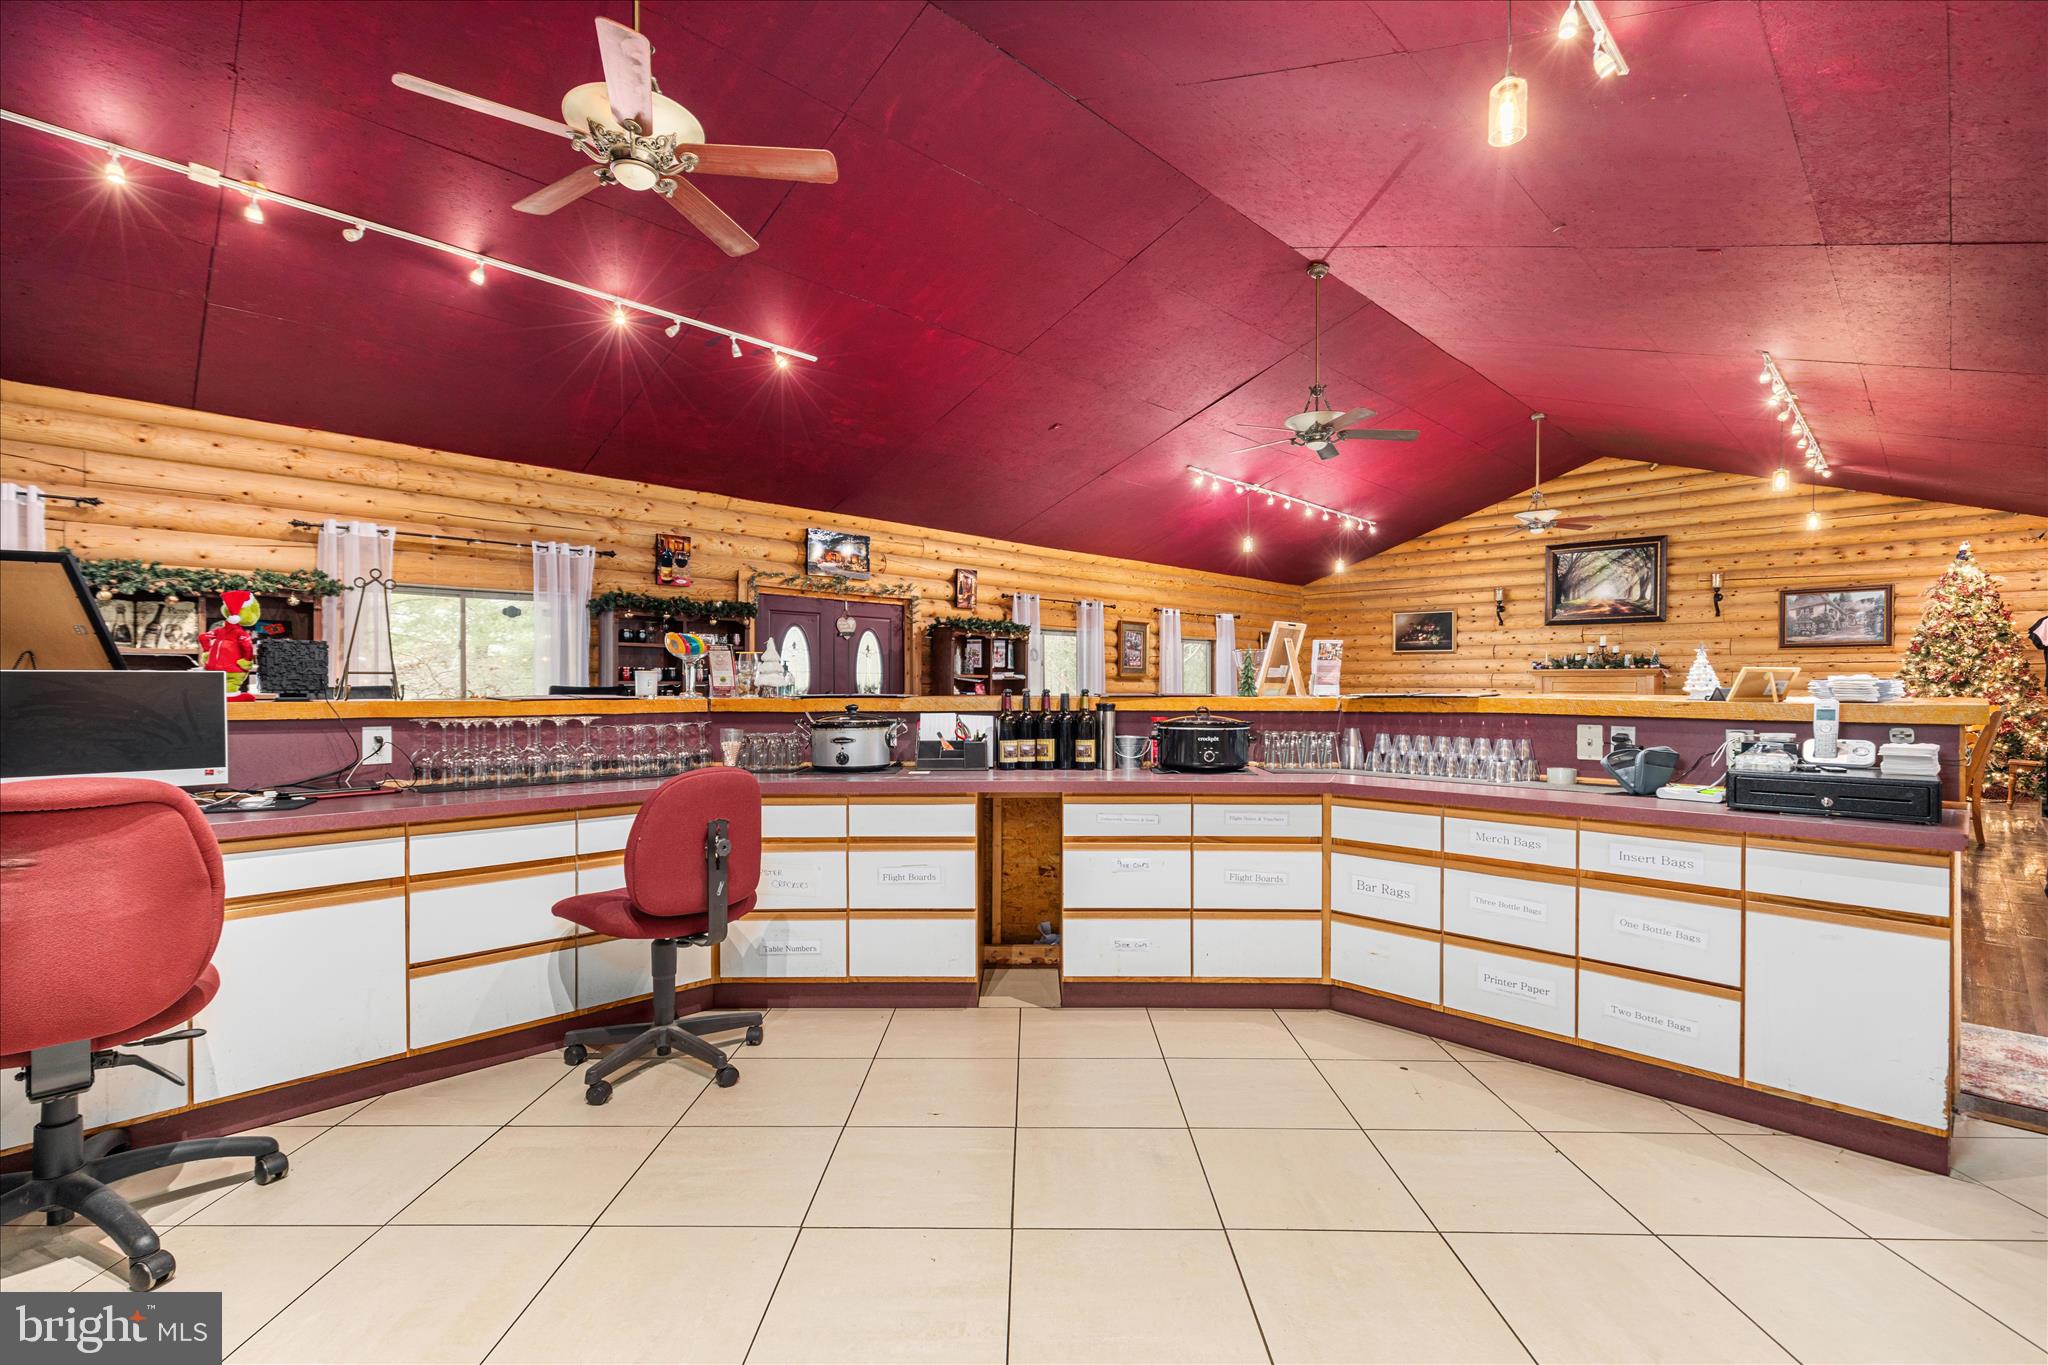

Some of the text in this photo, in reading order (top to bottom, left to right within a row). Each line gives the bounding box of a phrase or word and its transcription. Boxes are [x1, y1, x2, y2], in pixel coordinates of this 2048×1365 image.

[1475, 831, 1542, 849] Merch Bags
[1618, 850, 1695, 869] Insert Bags
[882, 873, 937, 882] Flight Boards
[1229, 872, 1284, 883] Flight Boards
[1357, 879, 1411, 899] Bar Rags
[1474, 896, 1543, 916] Three Bottle Bags
[1619, 918, 1702, 943] One Bottle Bags
[1483, 973, 1518, 988] Printer
[1520, 981, 1551, 996] Paper
[1610, 1004, 1692, 1033] Two Bottle Bags
